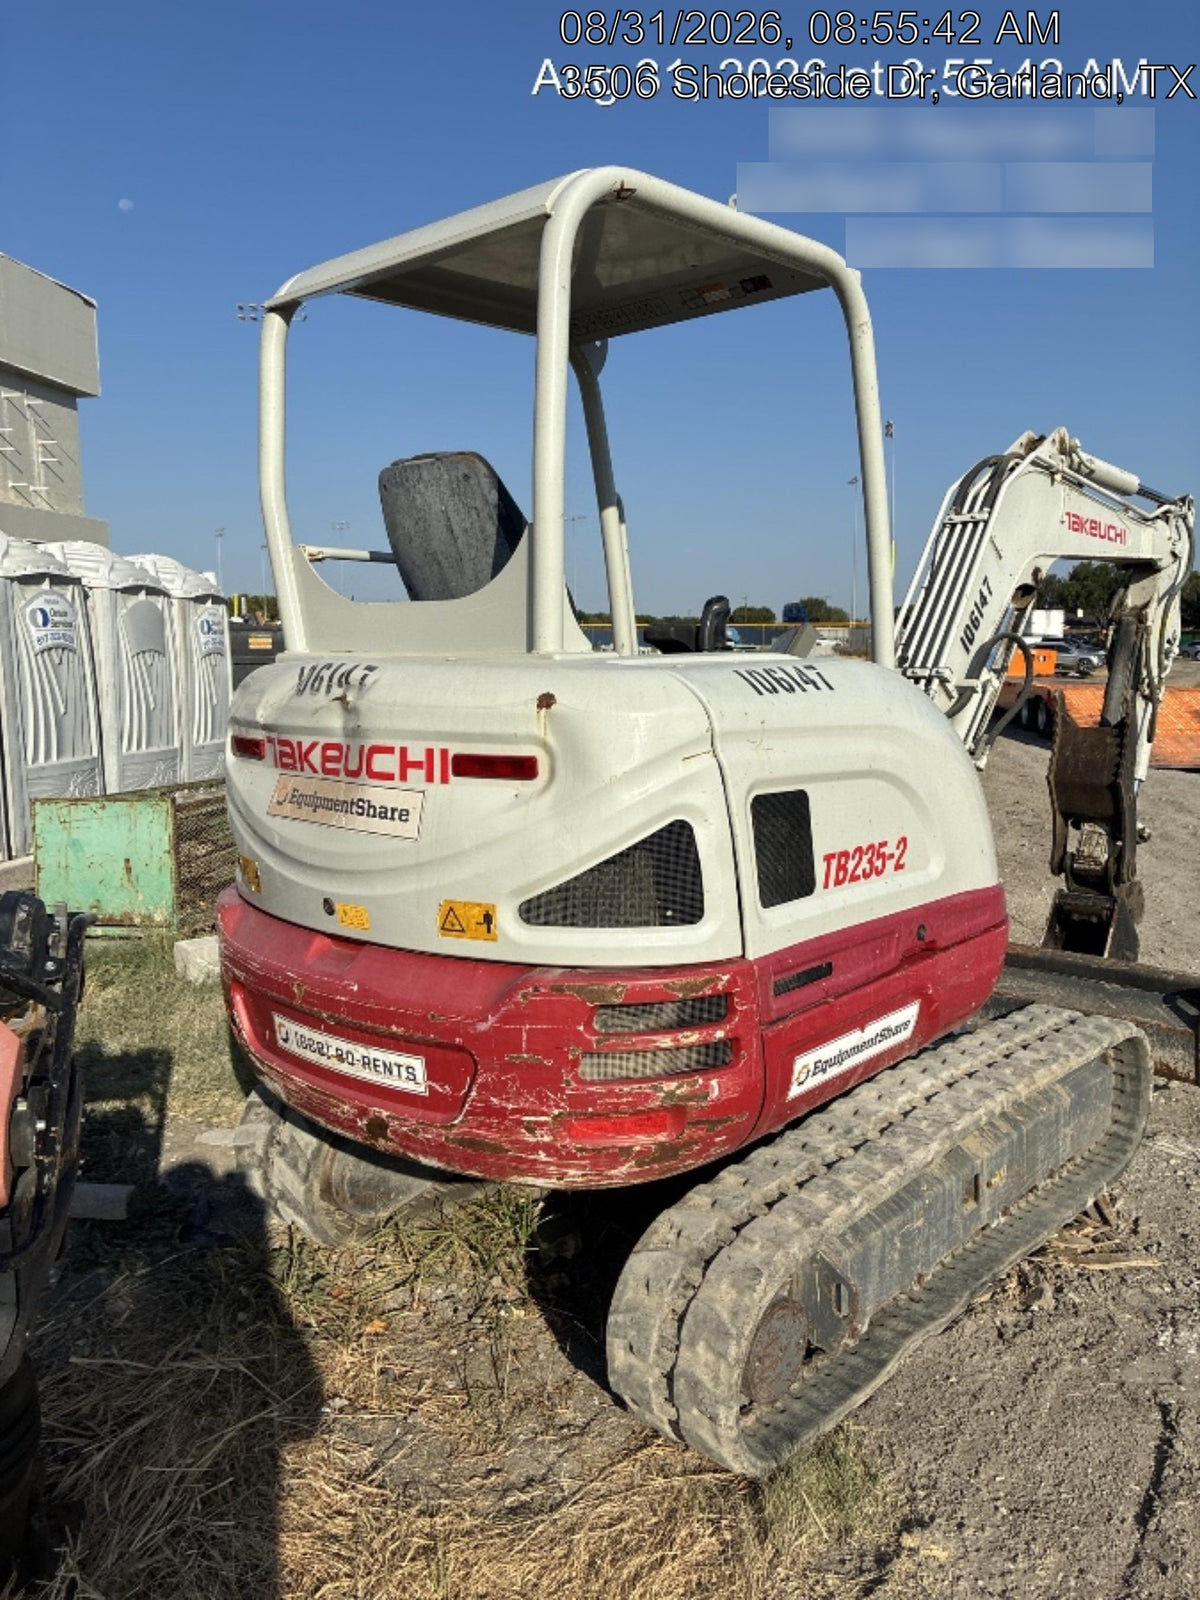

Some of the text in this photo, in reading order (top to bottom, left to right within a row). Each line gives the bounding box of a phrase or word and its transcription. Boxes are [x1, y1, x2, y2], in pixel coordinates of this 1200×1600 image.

[960, 574, 993, 656] 106147
[733, 664, 835, 696] 106147
[288, 788, 410, 823] EquipmentShare
[822, 835, 908, 889] TB235-2
[810, 1017, 911, 1078] EquipmentShare
